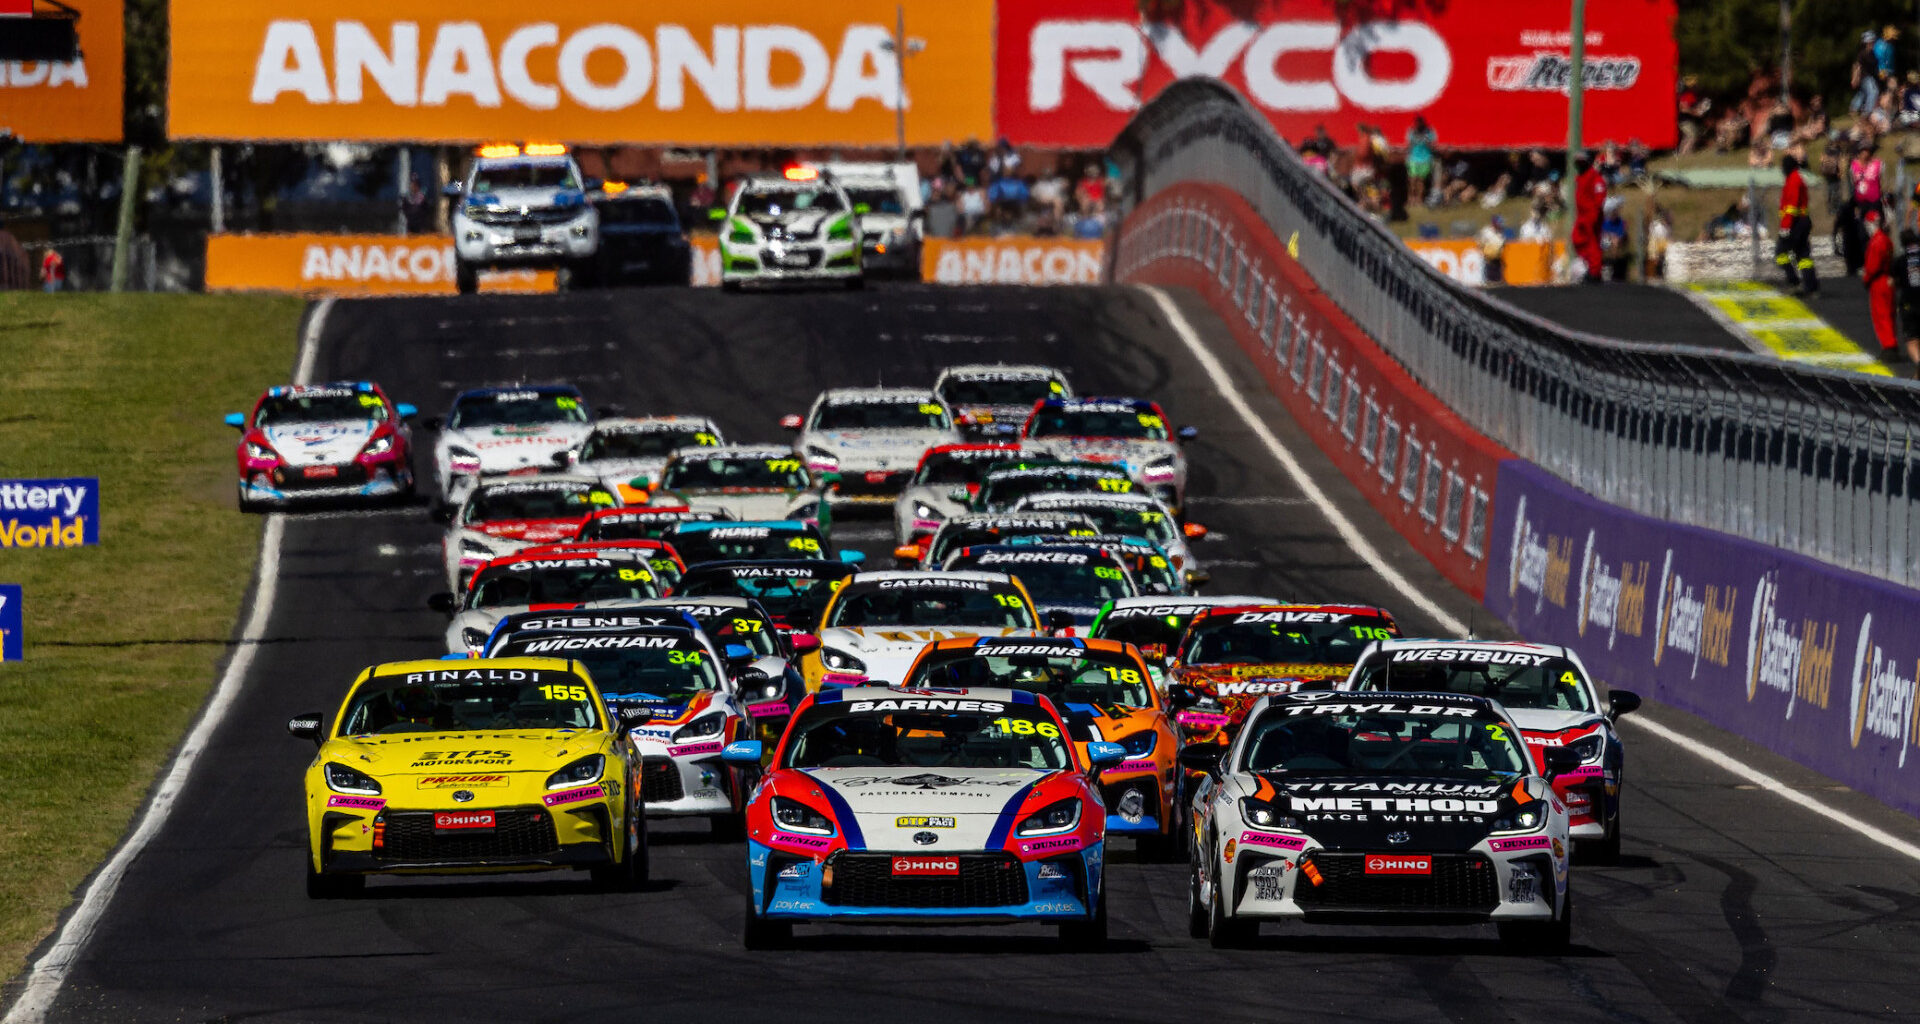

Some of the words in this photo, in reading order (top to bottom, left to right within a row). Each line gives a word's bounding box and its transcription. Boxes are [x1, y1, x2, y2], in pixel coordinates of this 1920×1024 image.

[251, 19, 910, 111] ANACONDA
[1029, 20, 1452, 111] RYCO
[711, 526, 770, 540] HUME
[788, 537, 820, 551] 45
[508, 558, 611, 572] OWEN
[977, 551, 1088, 565] PARKER
[618, 568, 653, 582] 84
[732, 567, 813, 579] WALTON
[1093, 565, 1124, 581] 69
[879, 579, 990, 592] CASABENE
[993, 593, 1024, 609] 19
[520, 616, 668, 631] CHENEY
[1233, 610, 1353, 625] DAVEY
[733, 618, 763, 633] 37
[1350, 624, 1391, 641] 116
[524, 636, 680, 654] WICKHAM
[973, 645, 1085, 658] GIBBONS
[668, 650, 703, 666] 34
[1392, 649, 1550, 667] WESTBURY
[406, 669, 540, 685] RINALDI
[1103, 666, 1141, 685] 18
[1559, 671, 1577, 687] 4
[538, 683, 588, 702] 155
[849, 699, 1006, 714] BARNES
[1285, 703, 1479, 718] TAYLOR
[993, 717, 1060, 738] 186
[1485, 723, 1509, 742] 2
[680, 742, 719, 754] DUNLOP
[411, 758, 515, 768] MOTORSPORT
[420, 775, 506, 785] PROLUBE
[555, 788, 601, 801] DUNLOP
[1285, 782, 1501, 795] TITANIUM
[1392, 790, 1491, 799] CARAVANS
[336, 797, 384, 807] DUNLOP
[1290, 797, 1498, 814] METHOD
[453, 815, 493, 826] HINO
[899, 817, 927, 827] OTP
[1306, 814, 1368, 822] RACE
[1384, 814, 1483, 823] WHEELS
[778, 835, 829, 848] DUNLOP
[1032, 838, 1080, 851] DUNLOP
[1250, 836, 1302, 847] DUNLOP
[1503, 839, 1548, 849] DUNLOP
[912, 861, 957, 871] HINO
[1386, 860, 1428, 870] HINO
